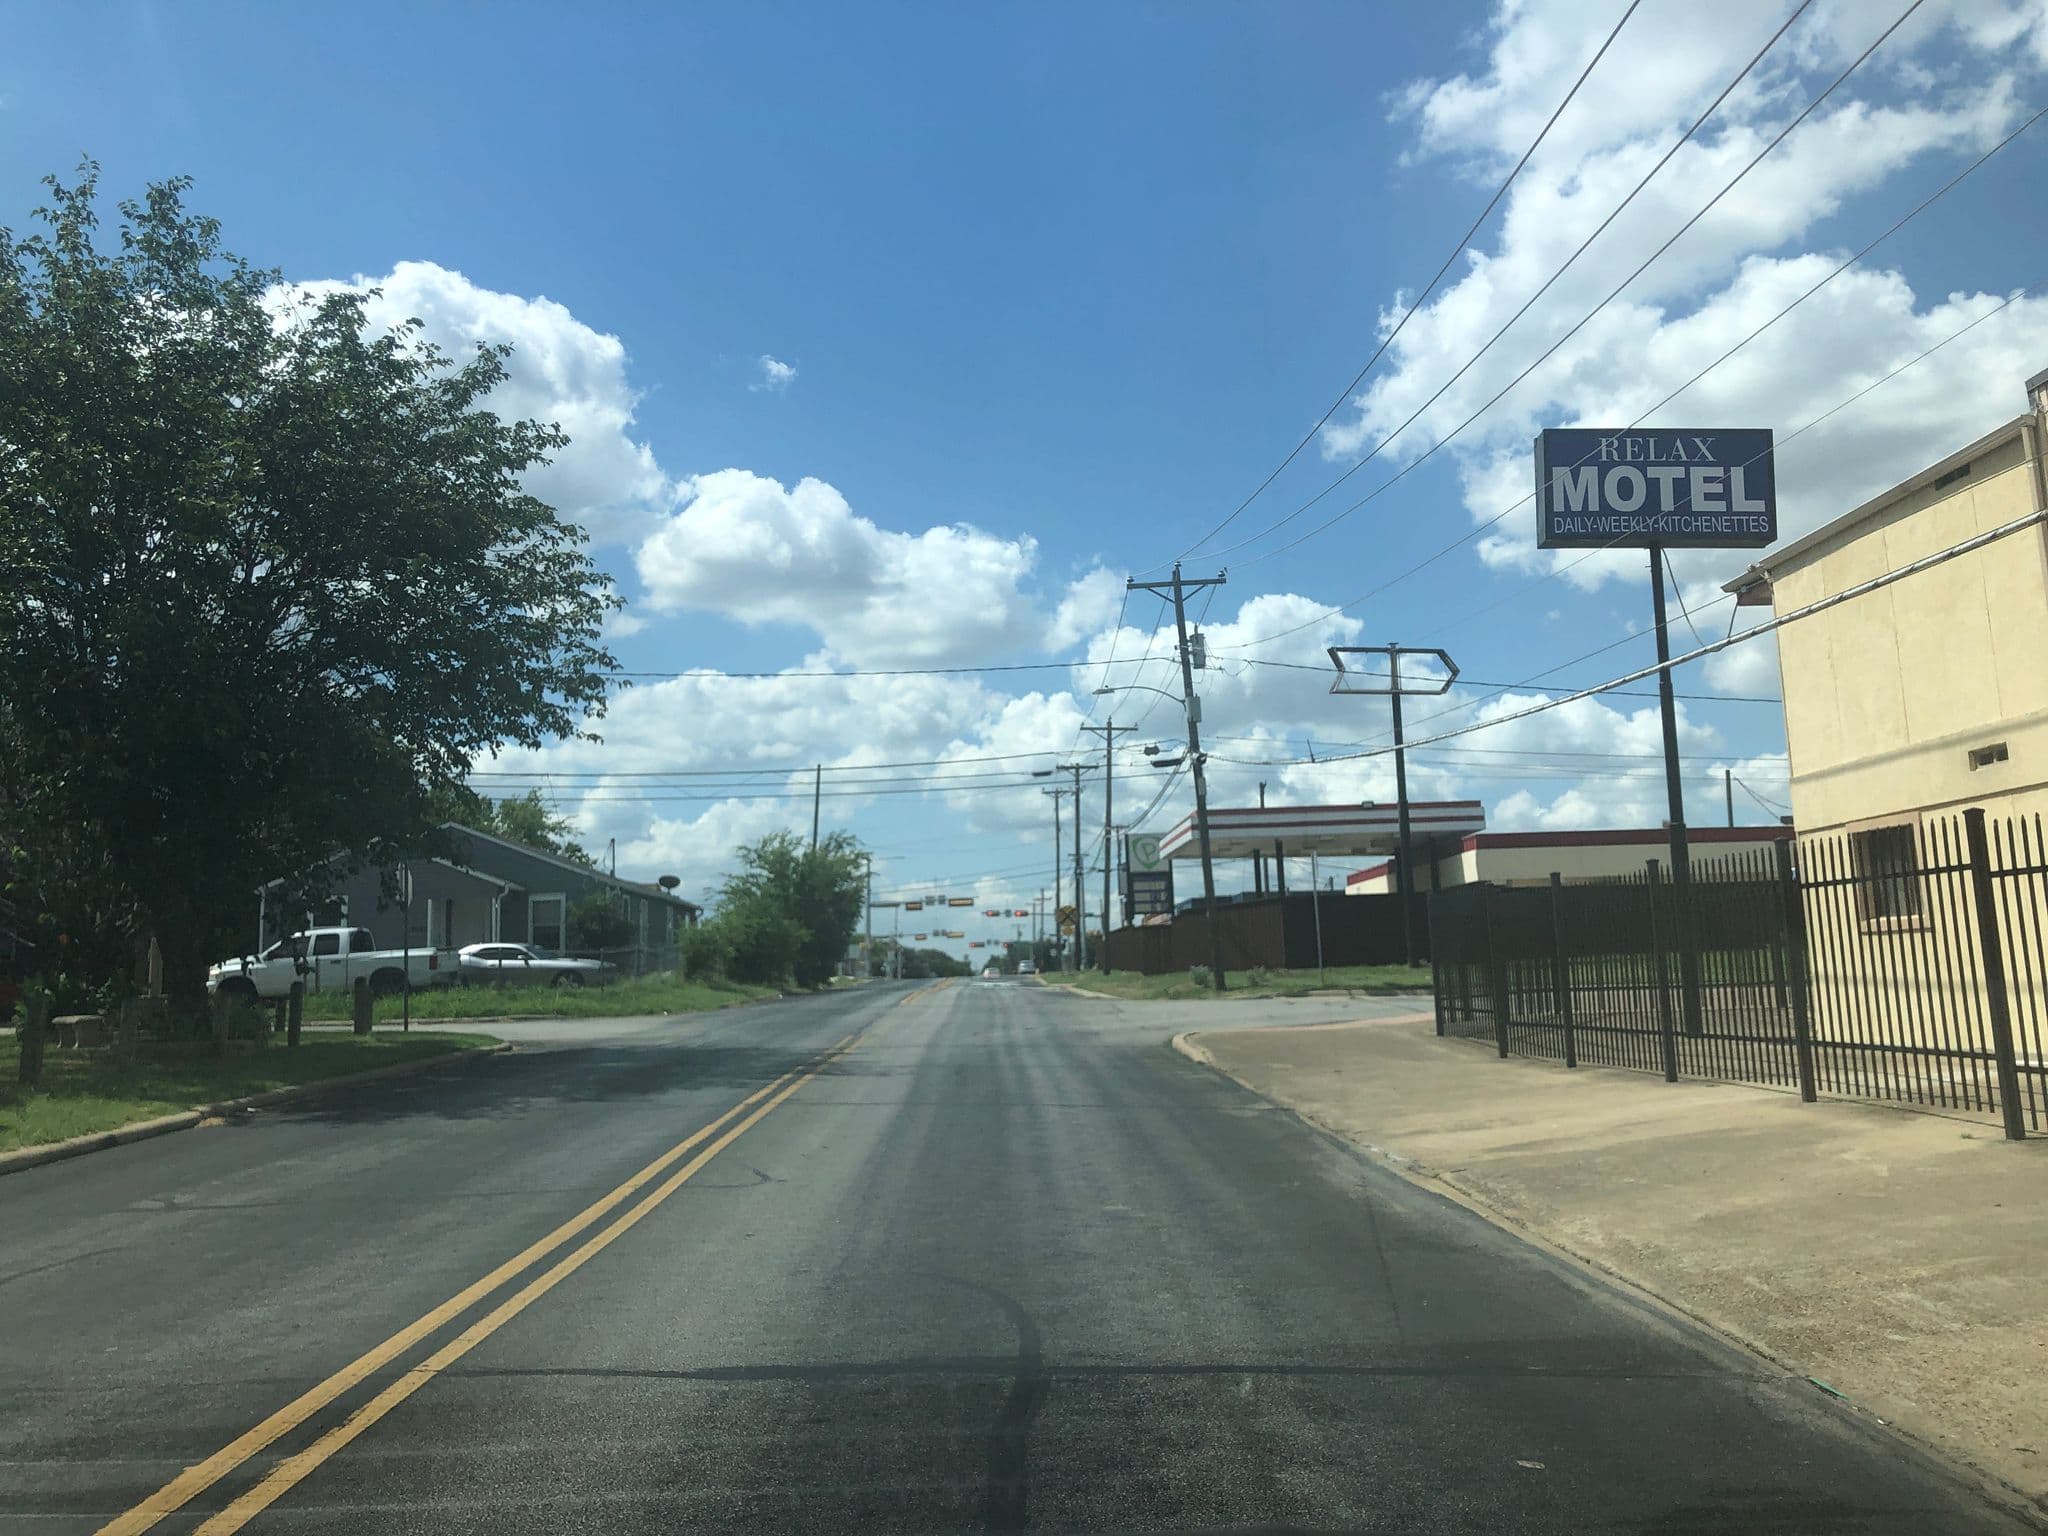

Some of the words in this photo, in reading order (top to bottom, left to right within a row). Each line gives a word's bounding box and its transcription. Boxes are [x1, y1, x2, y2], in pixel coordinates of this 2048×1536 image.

[1599, 437, 1716, 461] RELAX
[1552, 465, 1765, 512] MOTEL
[1554, 515, 1769, 534] DAILY-WEEKLY-KITCHENETTES
